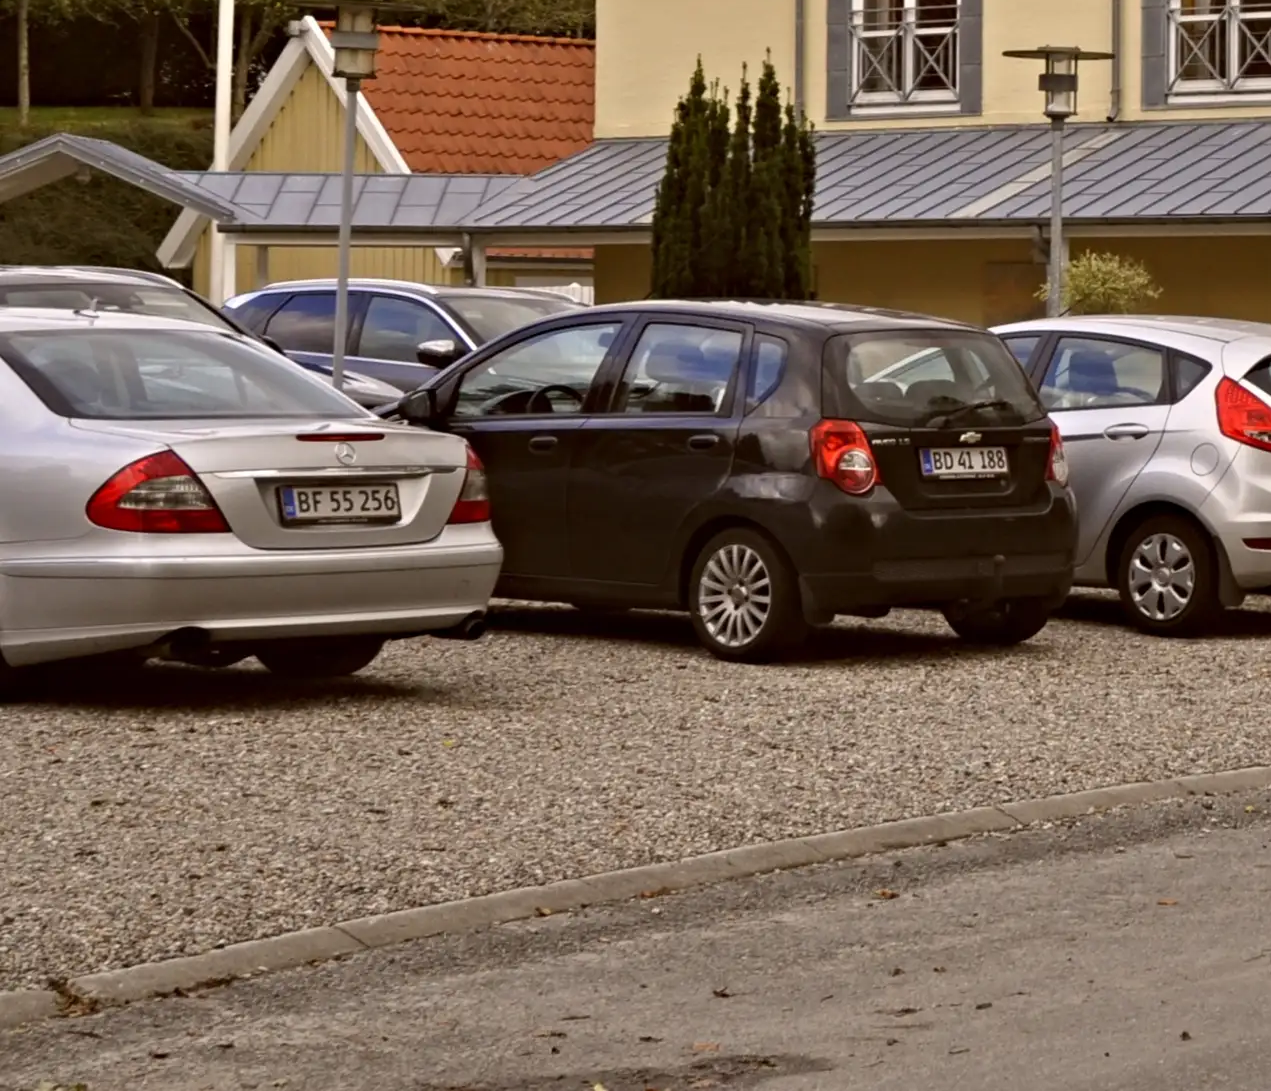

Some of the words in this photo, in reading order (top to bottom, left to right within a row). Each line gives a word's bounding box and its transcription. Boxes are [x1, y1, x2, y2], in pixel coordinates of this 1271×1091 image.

[932, 451, 954, 471] BD
[958, 451, 974, 469] 41
[979, 450, 1005, 469] 188
[297, 491, 323, 513] BF
[329, 490, 354, 512] 55
[358, 489, 396, 512] 256
